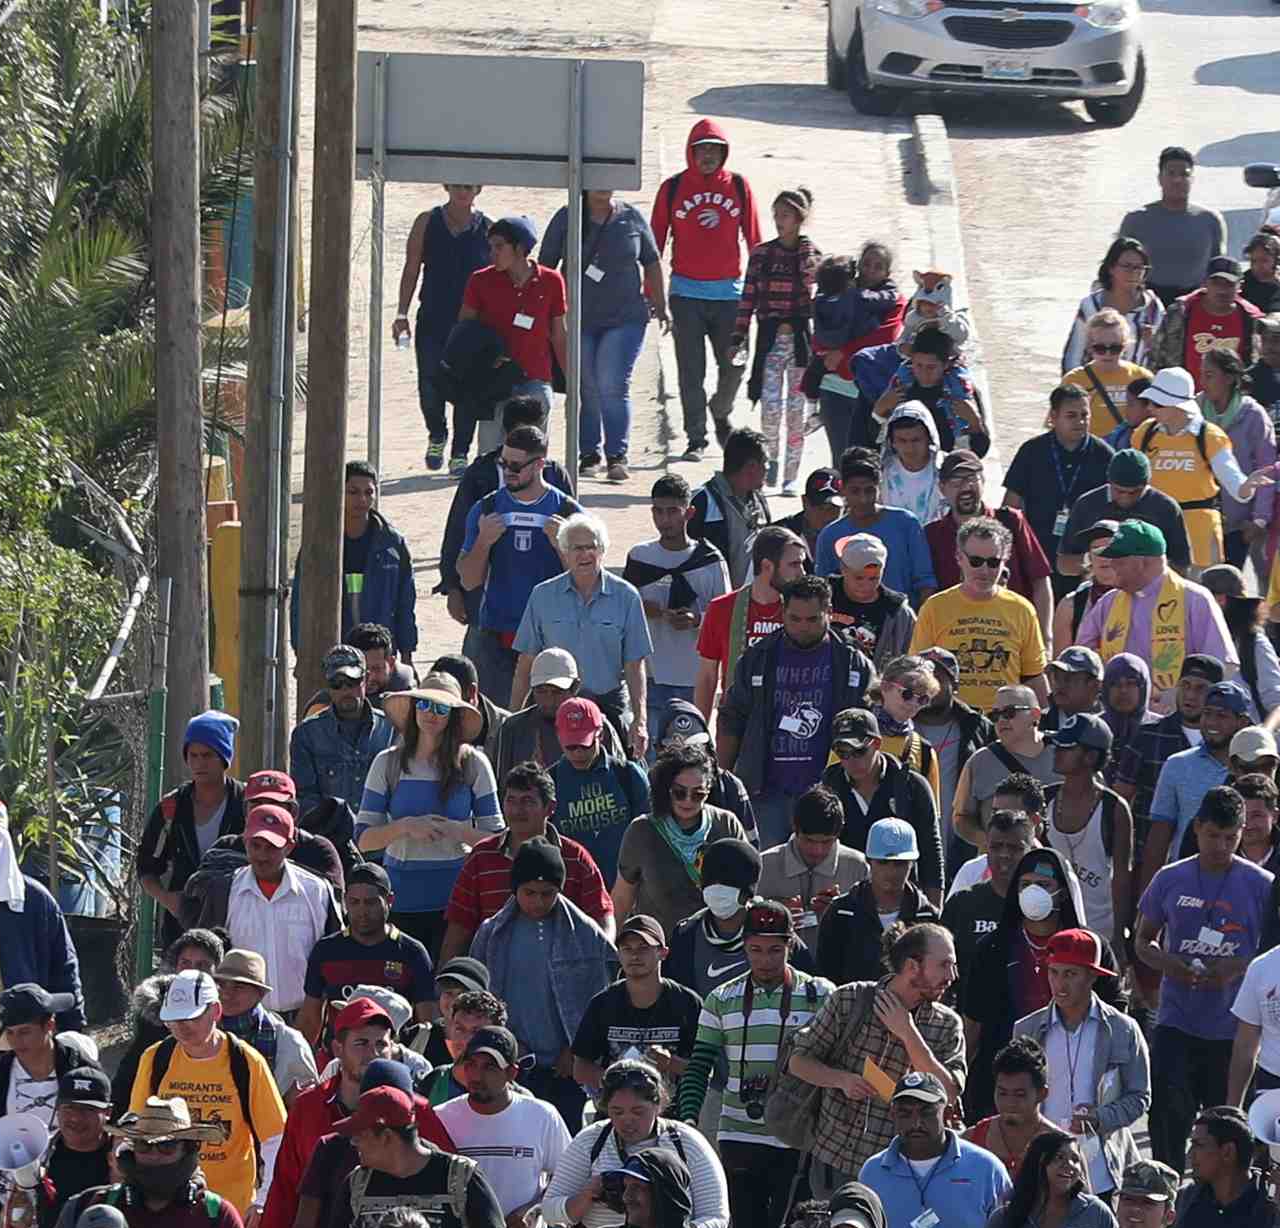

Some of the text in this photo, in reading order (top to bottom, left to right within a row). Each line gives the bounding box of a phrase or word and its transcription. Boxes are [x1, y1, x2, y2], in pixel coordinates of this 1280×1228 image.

[675, 191, 740, 220] RAPTORS
[1155, 458, 1196, 472] LOVE
[580, 783, 602, 799] NO
[568, 793, 617, 818] MORE
[560, 807, 628, 833] EXCUSES
[1176, 895, 1205, 909] TEAM
[168, 1081, 224, 1092] MIGRANTS
